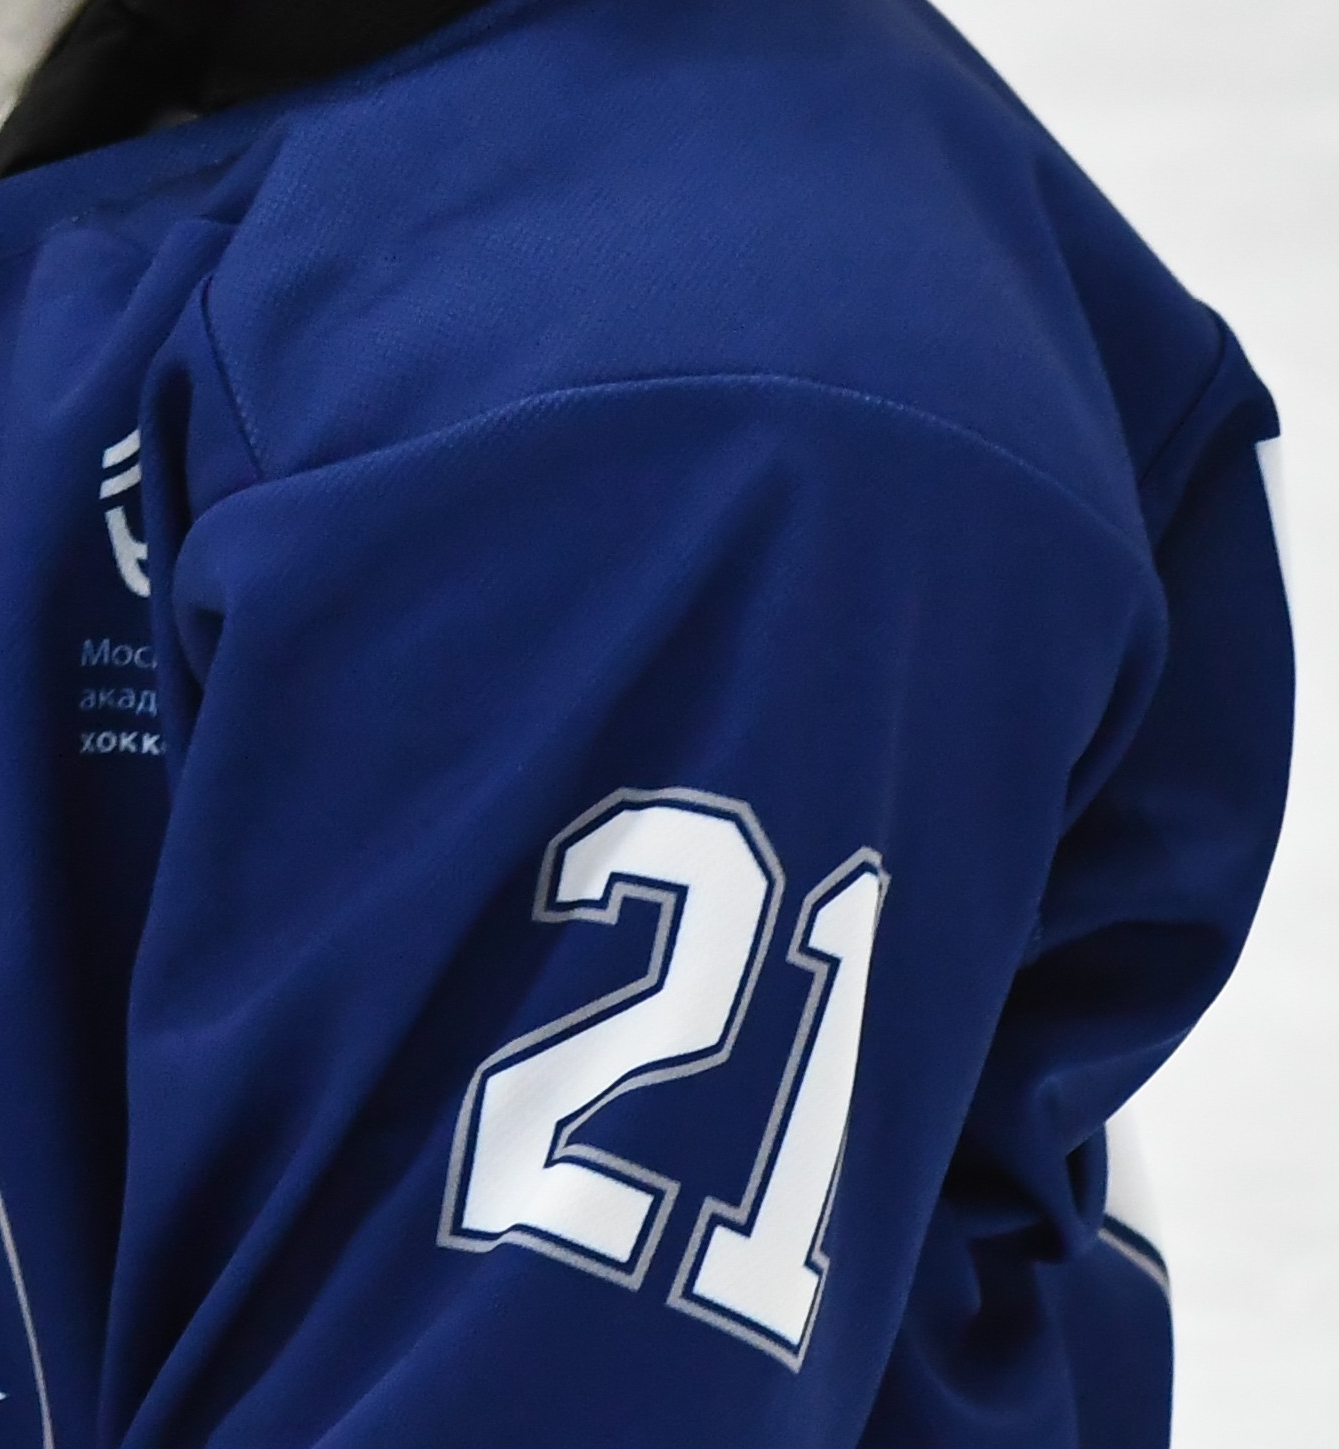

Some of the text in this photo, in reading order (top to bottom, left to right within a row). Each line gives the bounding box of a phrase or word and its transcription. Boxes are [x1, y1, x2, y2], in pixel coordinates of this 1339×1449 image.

[81, 637, 158, 668] Мос
[80, 731, 167, 755] хокк
[436, 786, 891, 1374] 21
